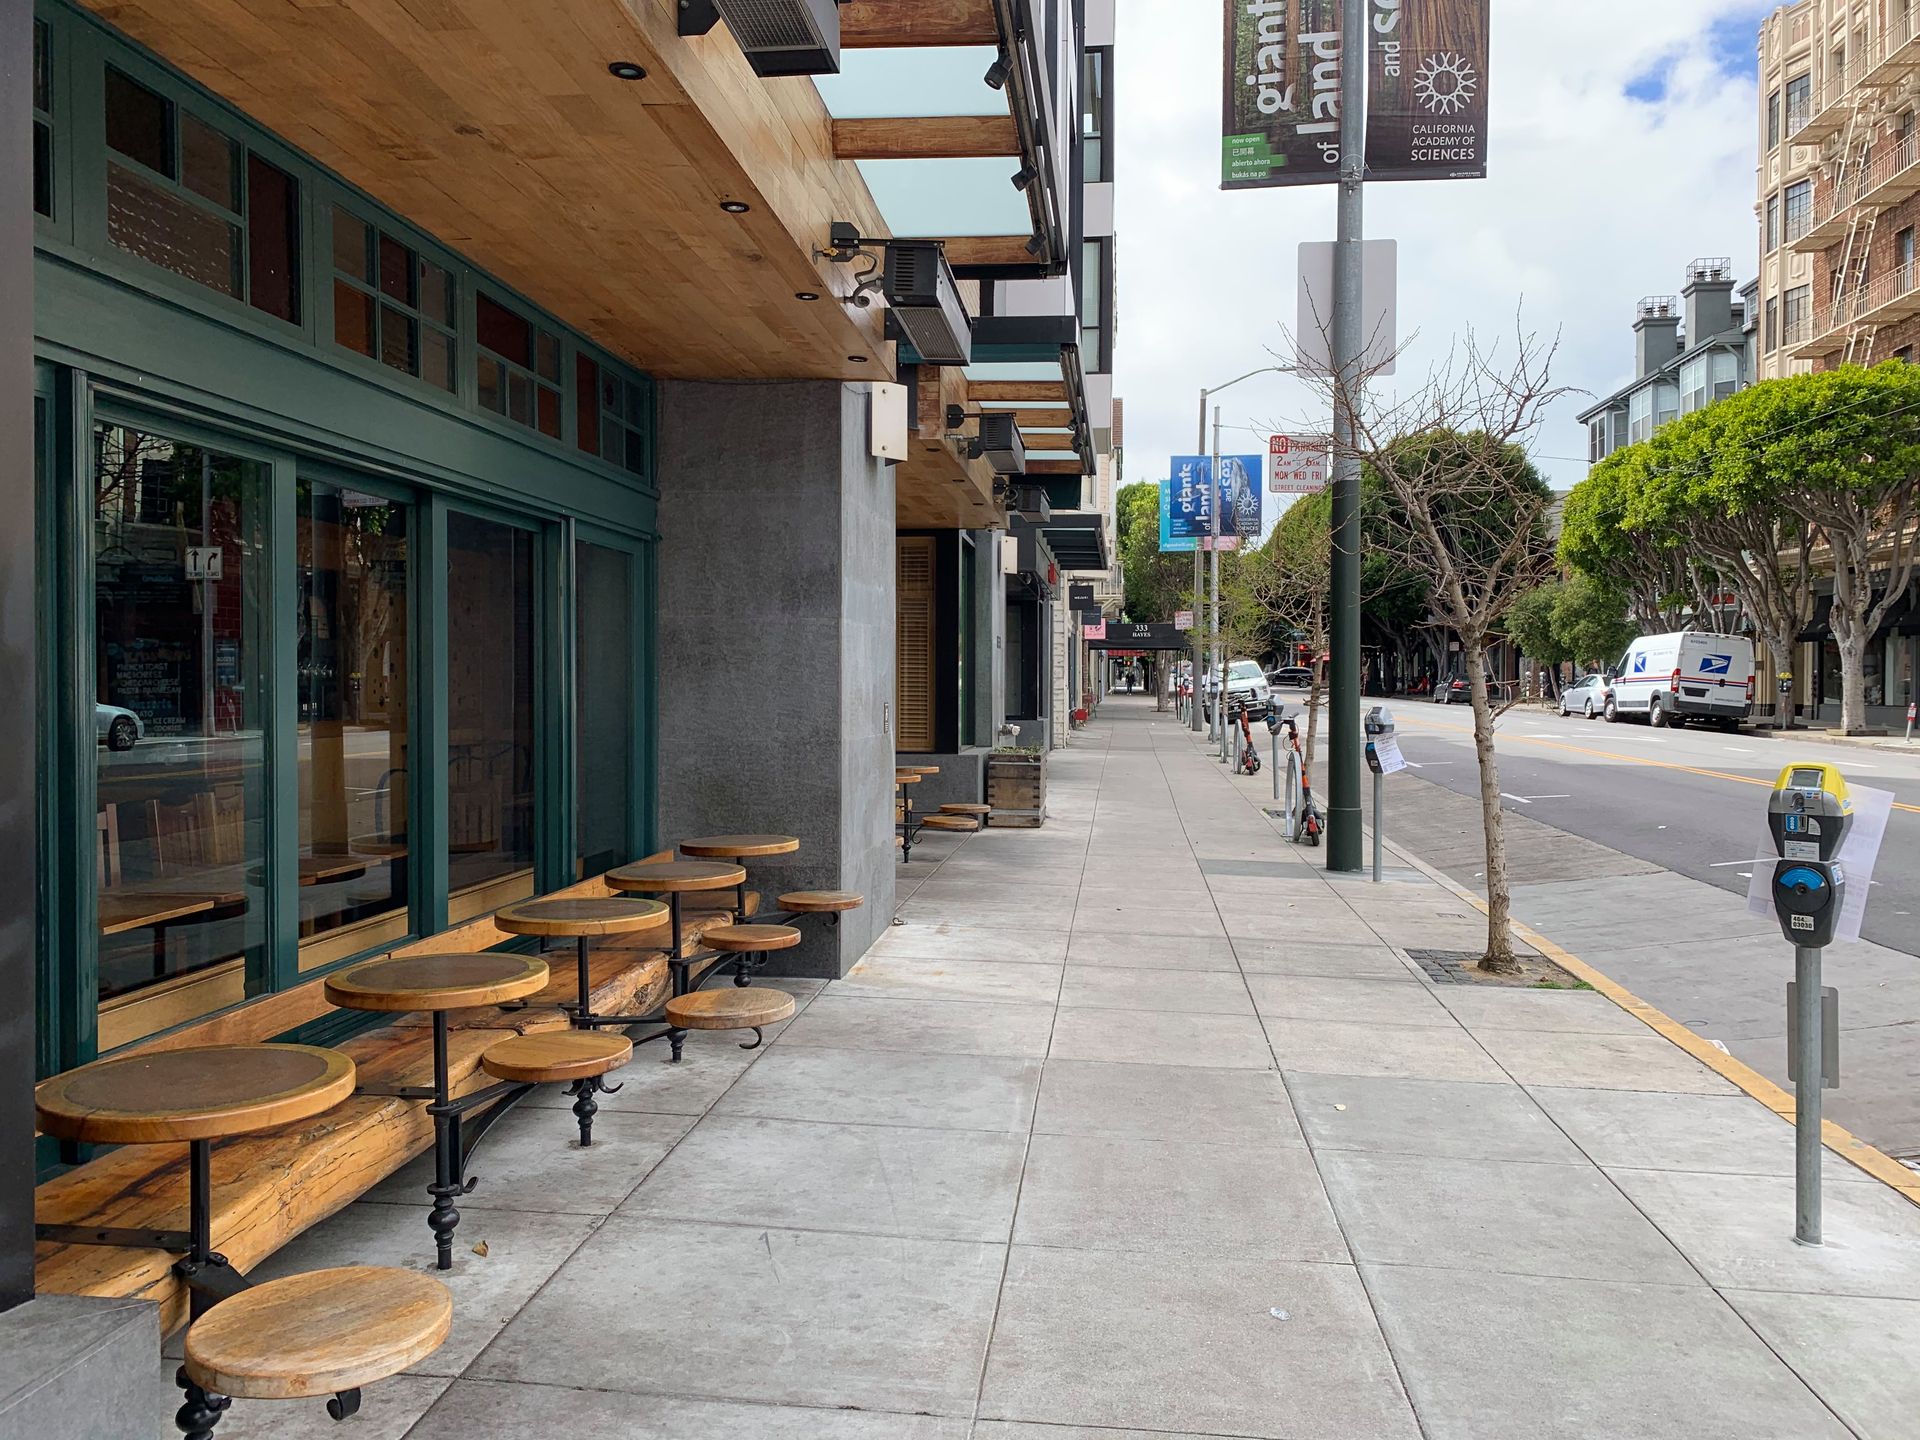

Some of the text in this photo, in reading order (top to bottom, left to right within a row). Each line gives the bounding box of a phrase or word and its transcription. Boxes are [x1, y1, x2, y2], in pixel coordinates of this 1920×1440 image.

[1378, 41, 1401, 77] and
[1296, 31, 1342, 164] of land
[1412, 124, 1475, 134] CALIFORNIA
[1245, 136, 1261, 144] open
[1411, 136, 1475, 146] ACADEMY OF
[1410, 148, 1475, 161] SCIENCES
[1253, 158, 1271, 166] ahora
[1272, 438, 1287, 453] NO
[1221, 459, 1232, 487] sea
[1274, 471, 1322, 480] MON WED FRI
[1224, 488, 1232, 502] and
[1195, 483, 1211, 521] land
[1134, 624, 1148, 632] 333
